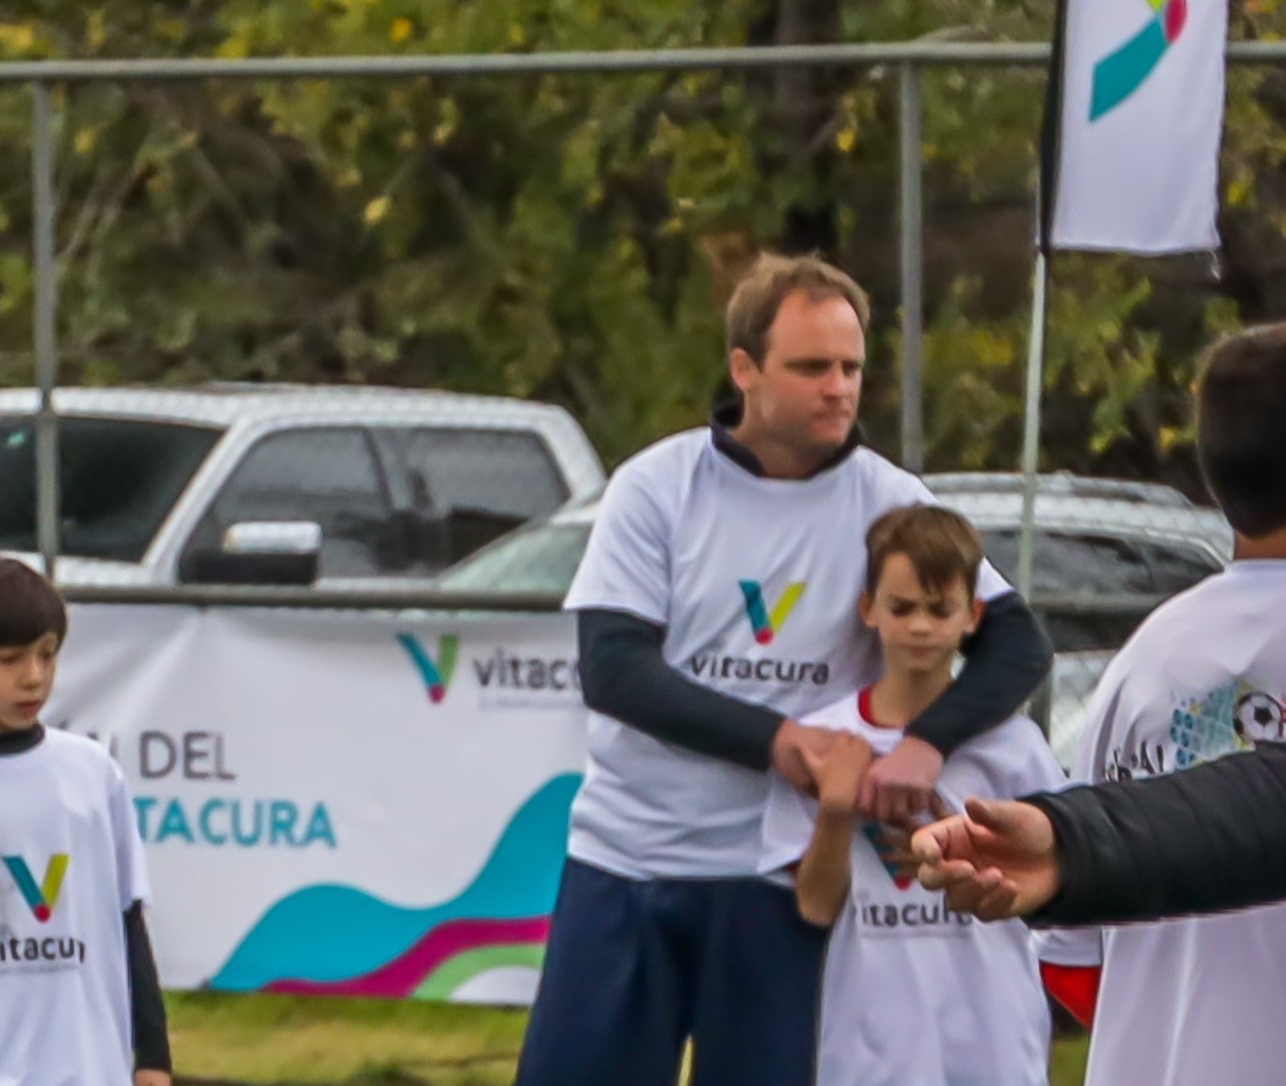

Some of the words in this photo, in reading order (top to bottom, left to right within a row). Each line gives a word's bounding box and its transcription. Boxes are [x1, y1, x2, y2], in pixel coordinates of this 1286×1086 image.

[473, 648, 579, 690] vitac
[690, 655, 830, 686] vitacura
[139, 730, 236, 781] DEL
[132, 796, 336, 848] TACURA
